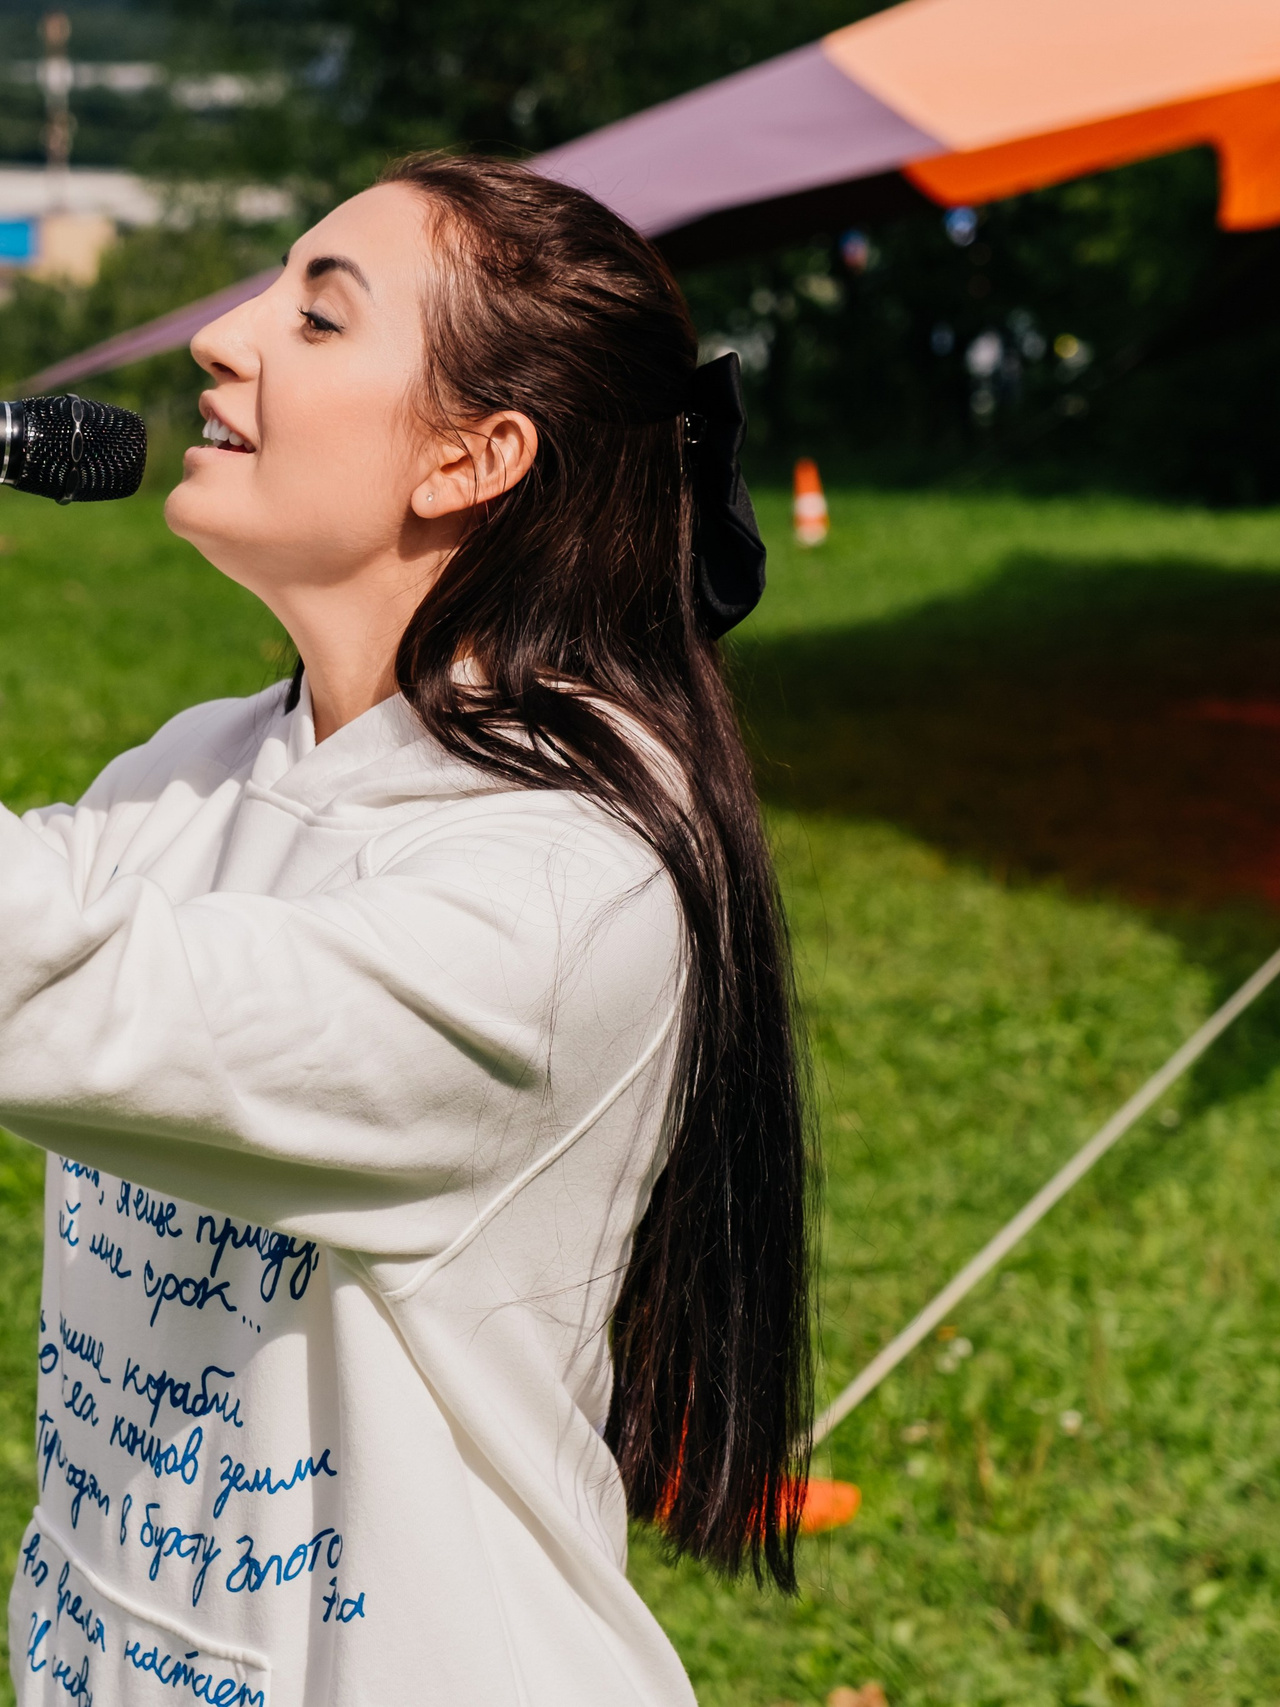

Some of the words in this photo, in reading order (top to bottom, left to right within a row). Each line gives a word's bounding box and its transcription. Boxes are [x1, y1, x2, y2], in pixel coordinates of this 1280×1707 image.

[122, 1357, 245, 1433] корабли
[109, 1414, 204, 1485] концов
[212, 1448, 338, 1519] земли
[140, 1502, 222, 1608] бухту
